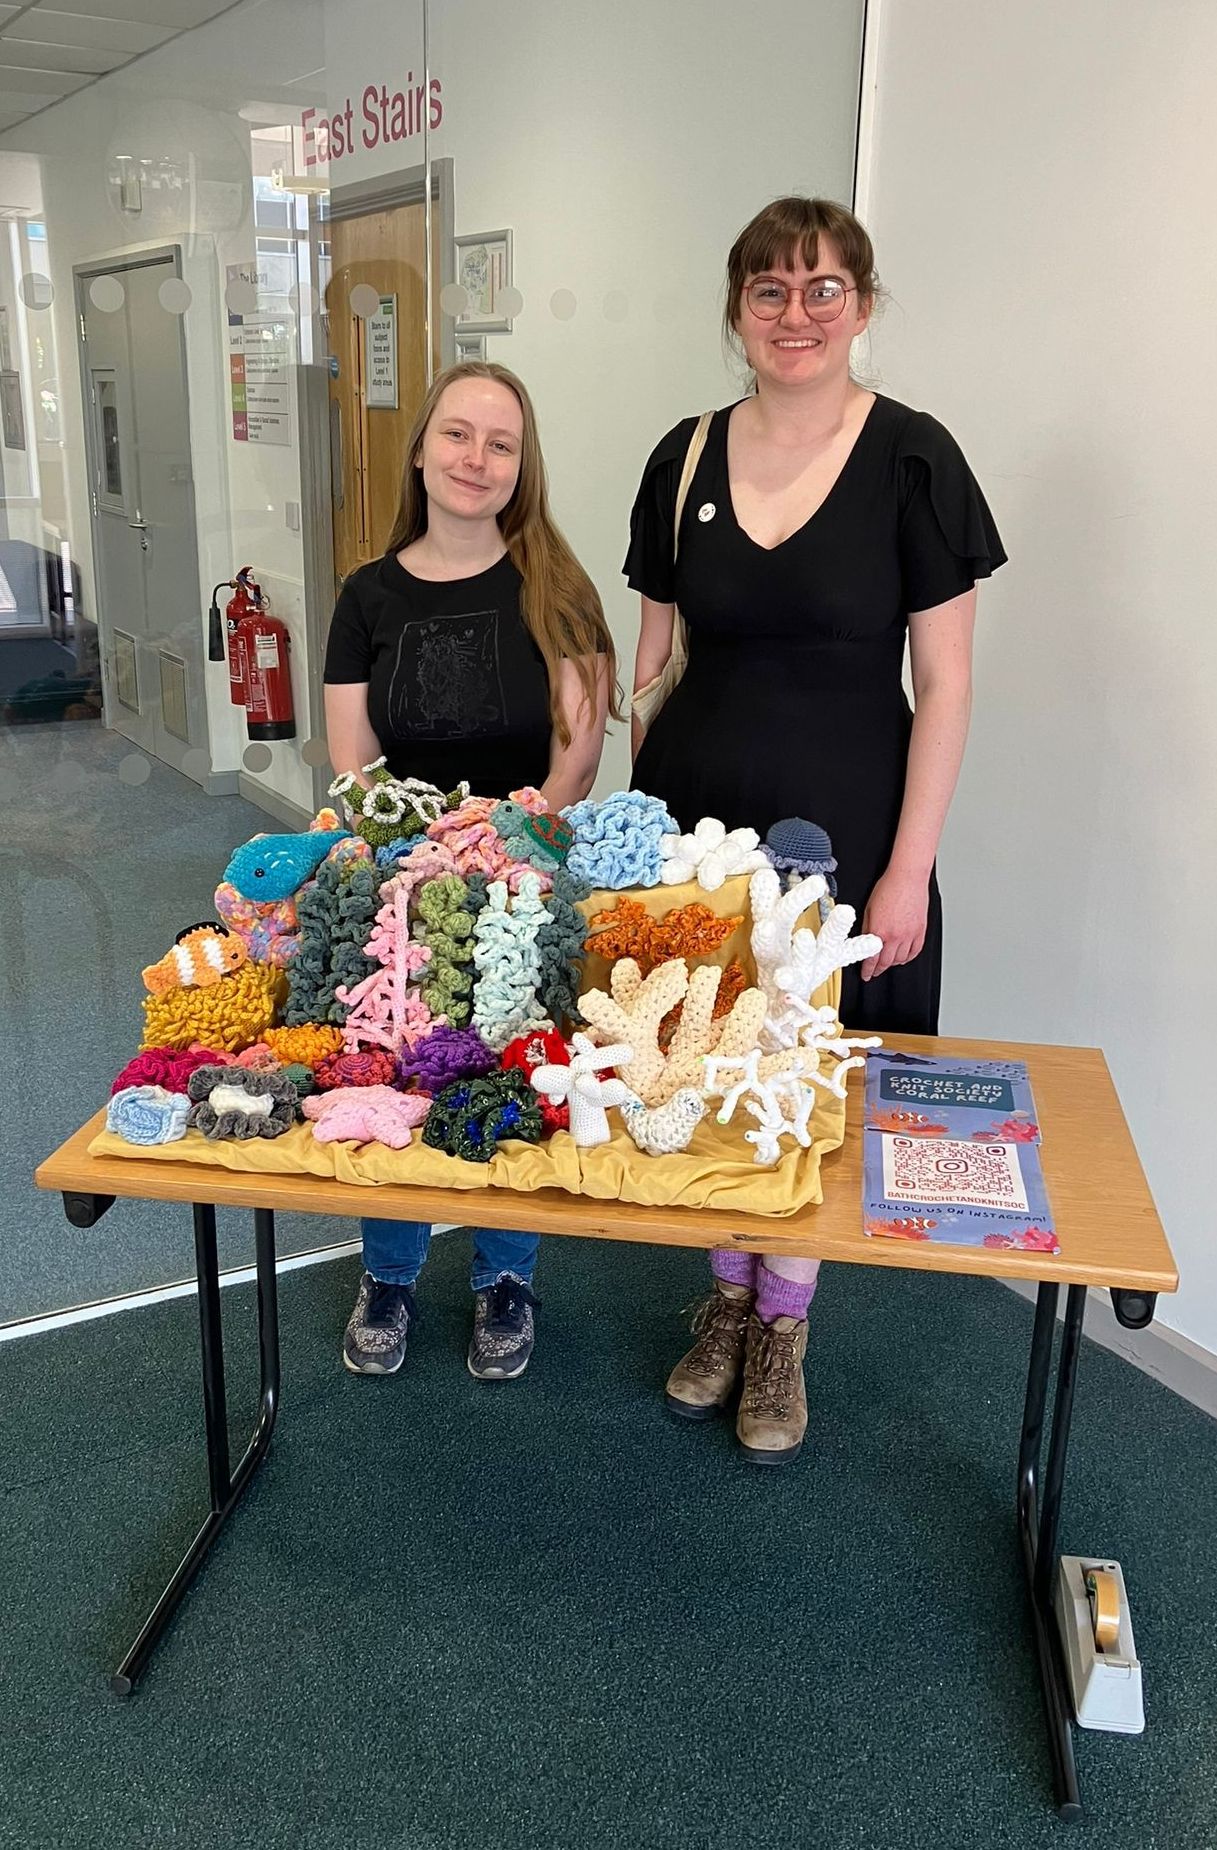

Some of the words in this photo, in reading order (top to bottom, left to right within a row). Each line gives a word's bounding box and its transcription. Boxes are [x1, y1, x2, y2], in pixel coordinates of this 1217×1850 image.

[302, 99, 354, 166] East
[362, 72, 443, 149] Stairs
[889, 1076, 964, 1088] CROCHET
[971, 1083, 1003, 1091] AND
[890, 1082, 928, 1091] KNIT
[934, 1086, 1002, 1097] SOCIETY
[896, 1089, 950, 1100] CORAL
[956, 1094, 998, 1104] REEF
[887, 1191, 1026, 1210] BATHCROCHETANDKNITSOC
[870, 1202, 922, 1213] FOLLOW
[947, 1207, 964, 1215] ON
